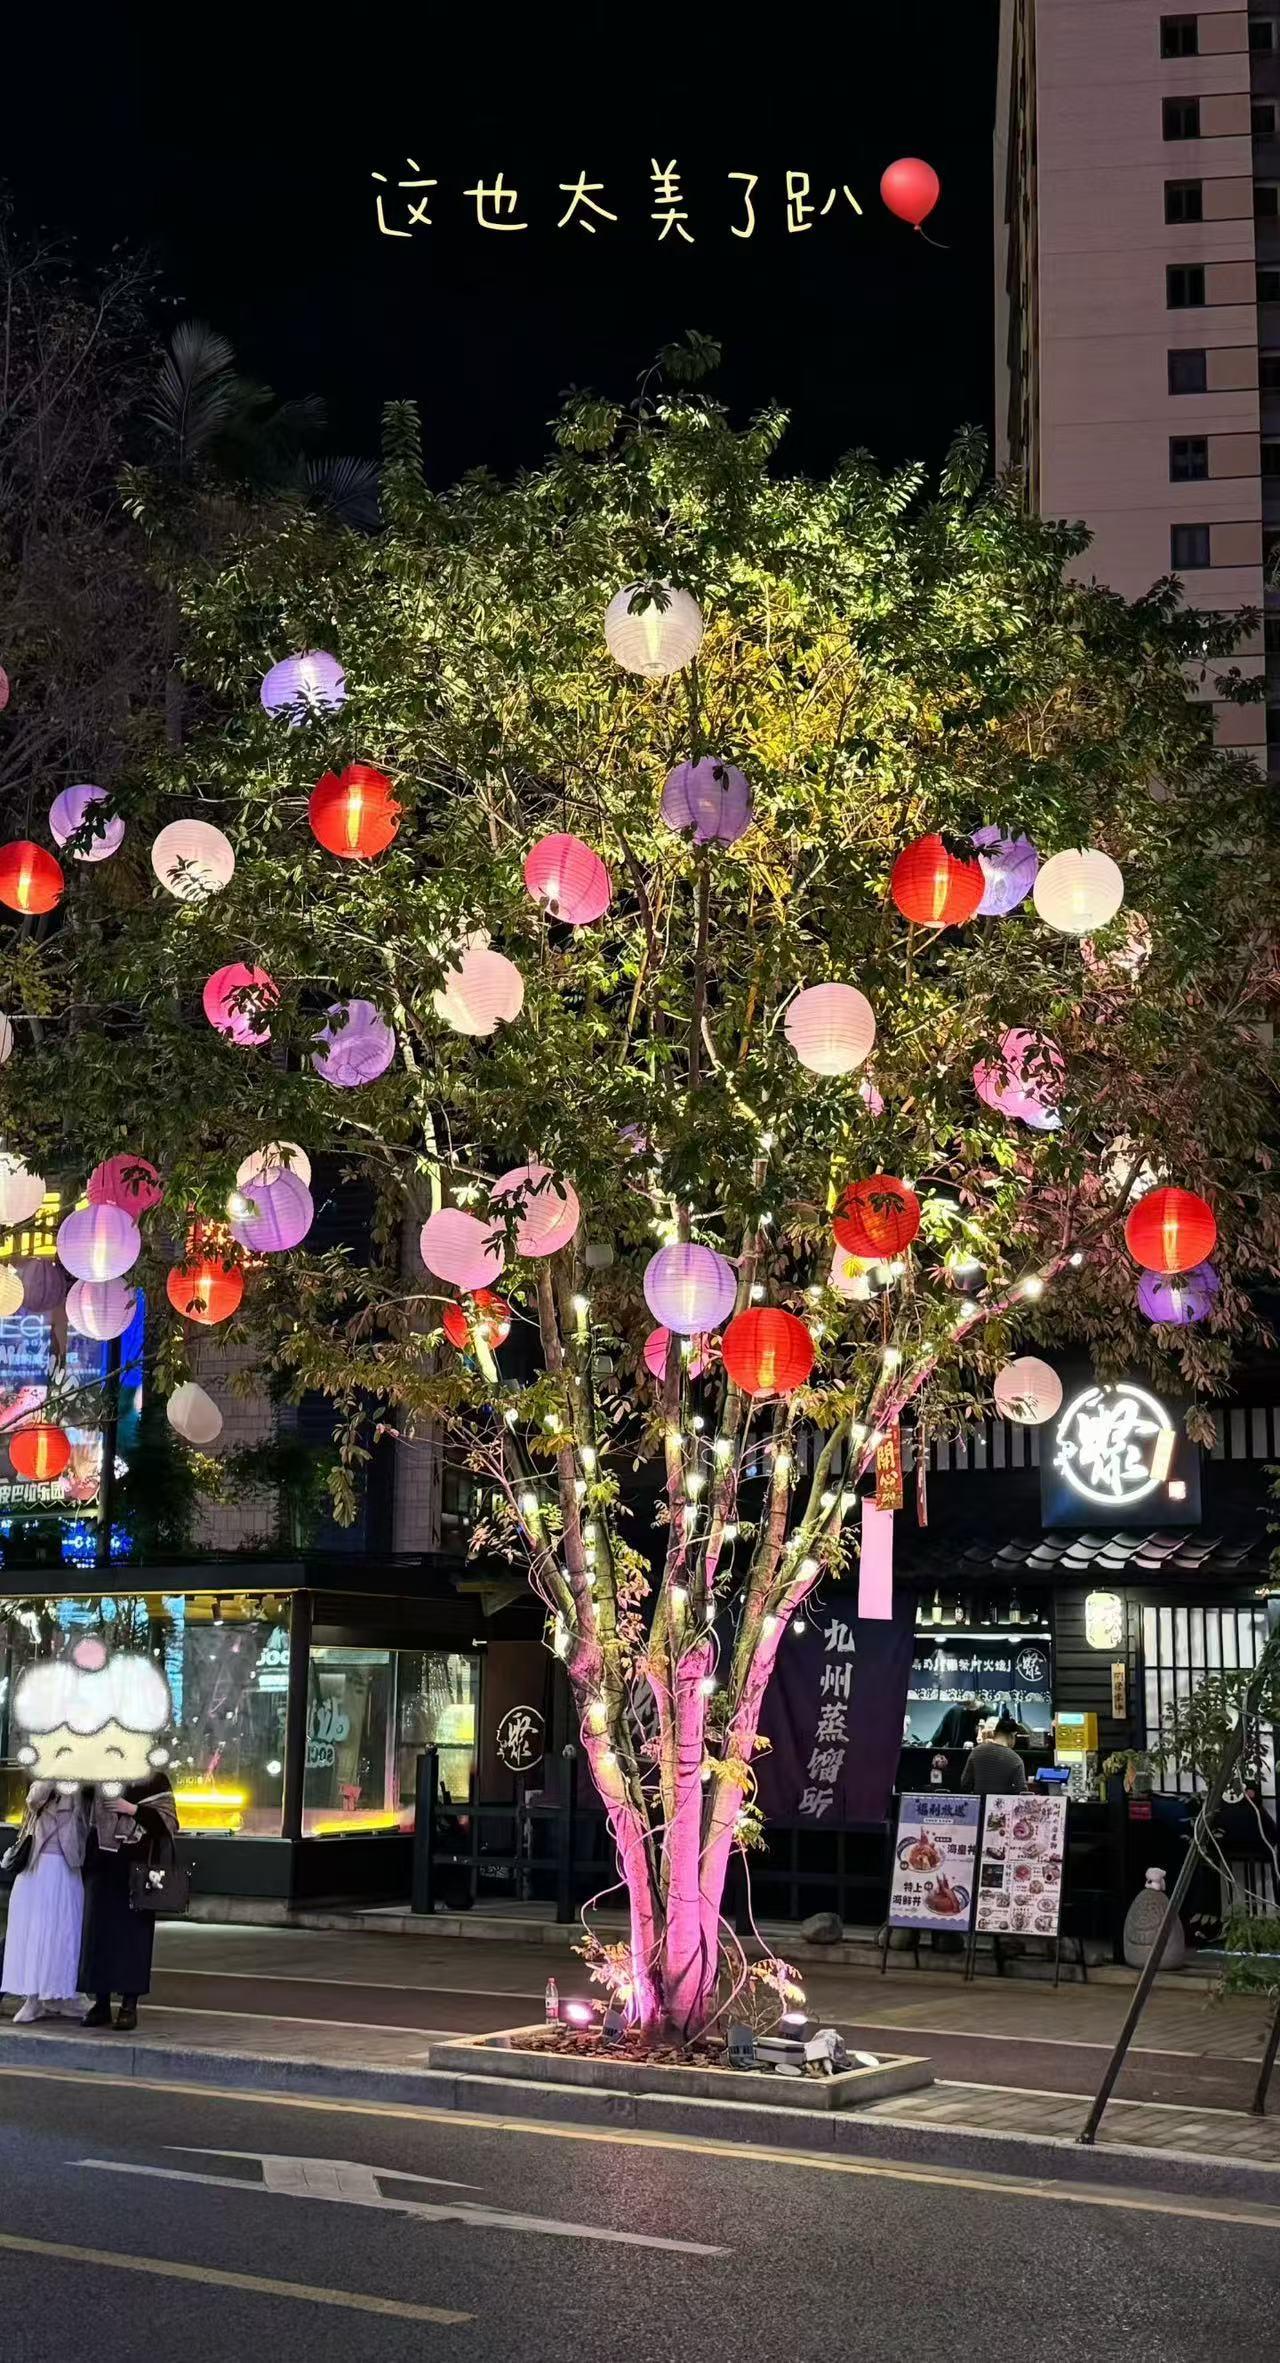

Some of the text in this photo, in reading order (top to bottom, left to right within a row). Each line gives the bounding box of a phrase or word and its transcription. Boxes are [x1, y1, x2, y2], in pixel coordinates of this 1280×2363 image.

[798, 1619, 856, 1819] 九州蒸馏所
